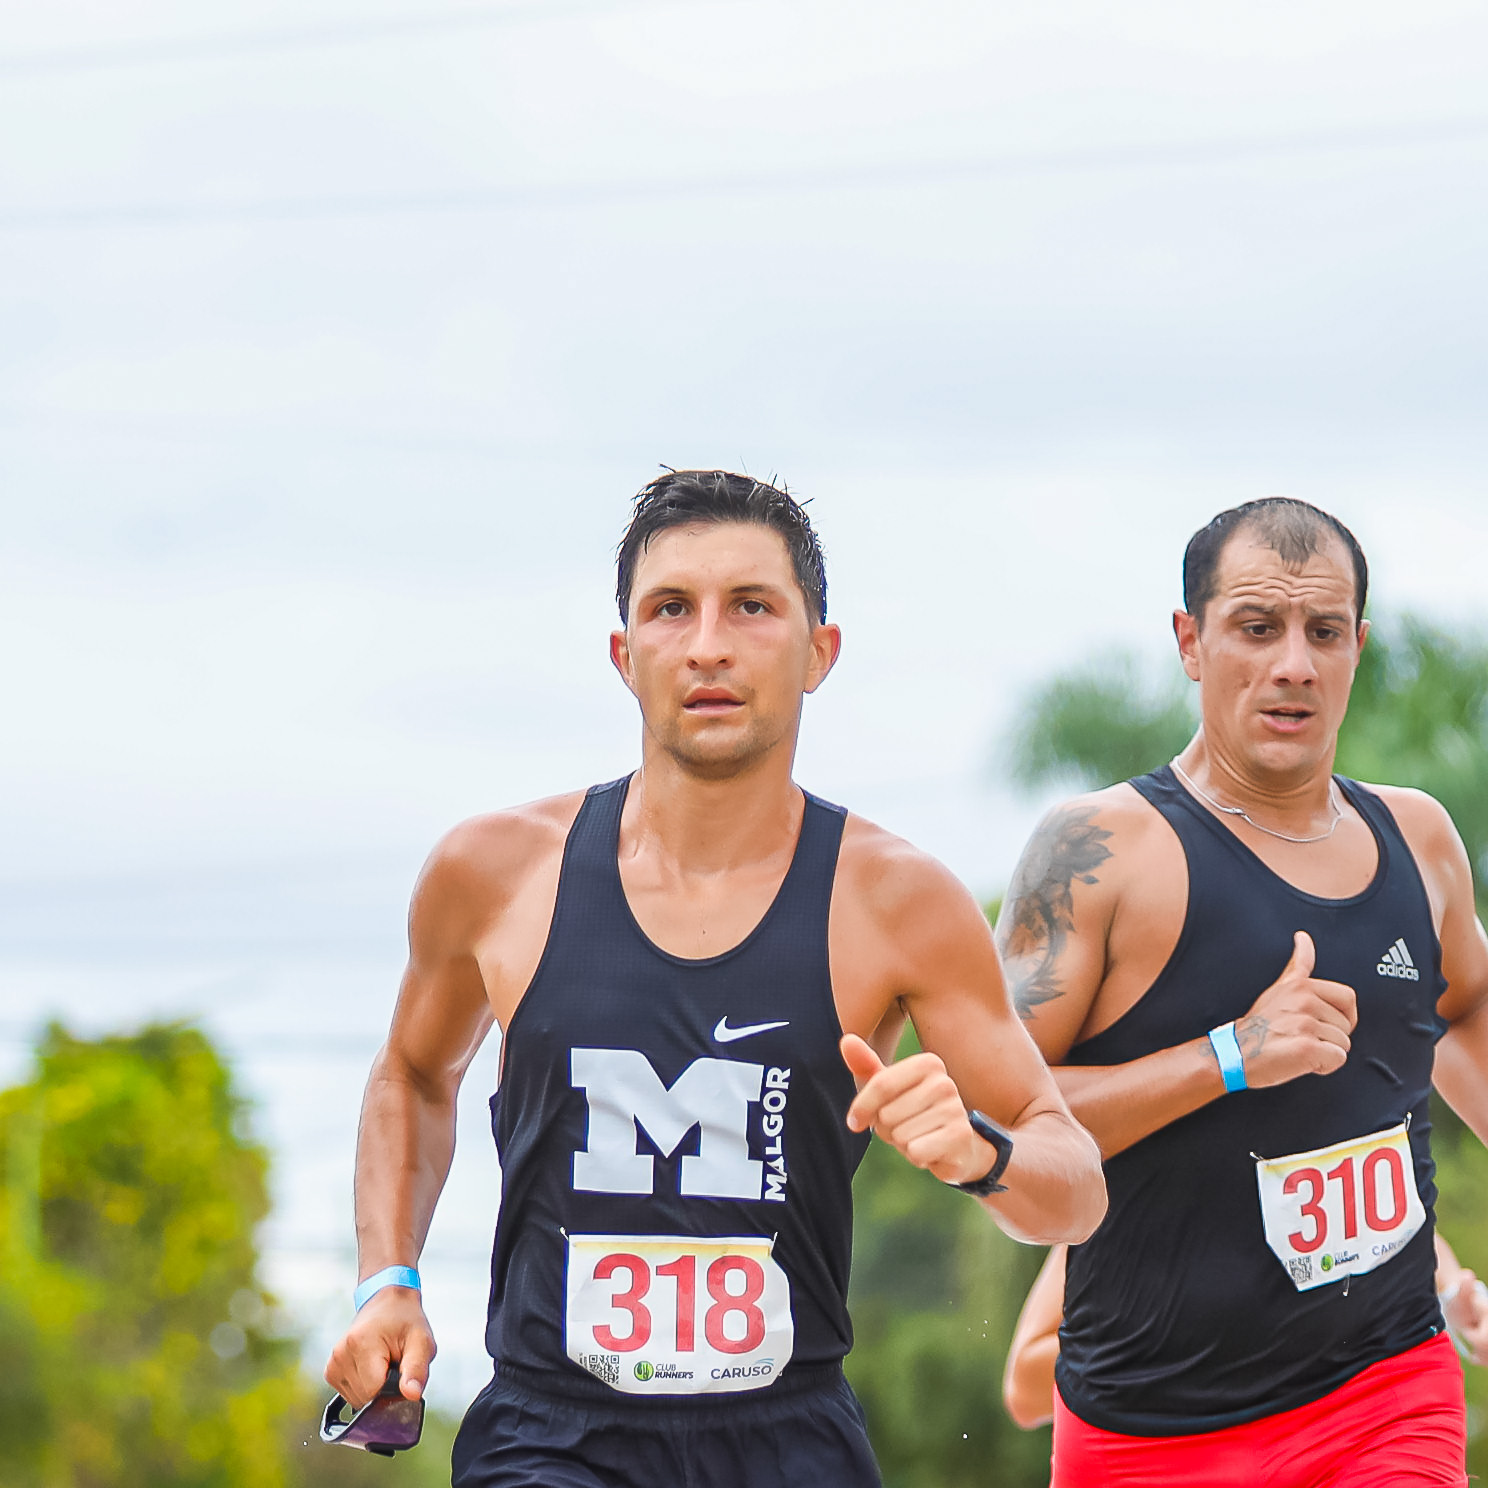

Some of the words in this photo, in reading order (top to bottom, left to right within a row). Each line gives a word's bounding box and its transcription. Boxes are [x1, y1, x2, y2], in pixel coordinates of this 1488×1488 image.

[1377, 962, 1420, 981] adidas
[570, 1047, 765, 1201] M
[762, 1067, 791, 1202] MALGOR
[1282, 1146, 1408, 1254] 310
[592, 1253, 766, 1354] 318
[655, 1363, 677, 1372] CLUB
[655, 1371, 694, 1379] RUNNER'S
[711, 1365, 772, 1380] CARUSO
